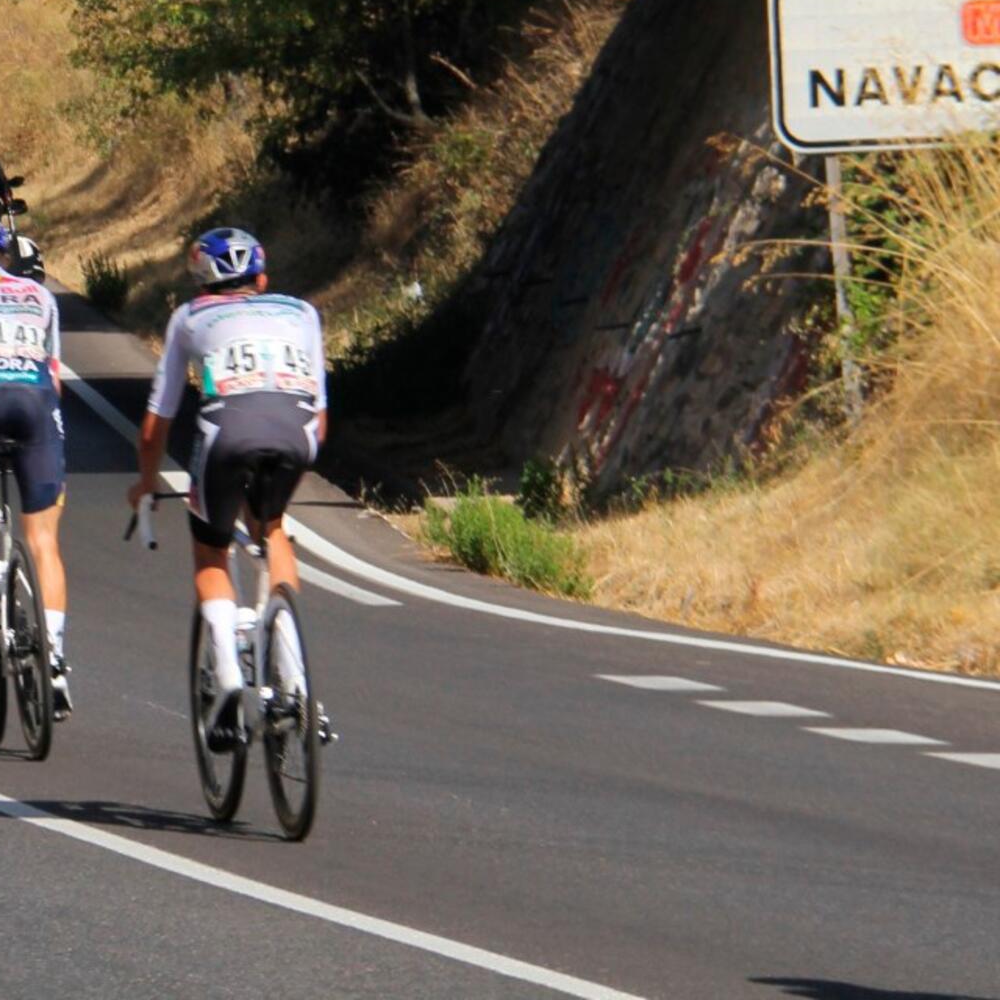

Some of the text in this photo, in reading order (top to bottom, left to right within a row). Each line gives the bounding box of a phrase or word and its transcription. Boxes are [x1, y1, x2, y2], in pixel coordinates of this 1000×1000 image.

[1, 282, 39, 294] Bull
[14, 324, 38, 345] 41
[225, 343, 313, 376] 45 45
